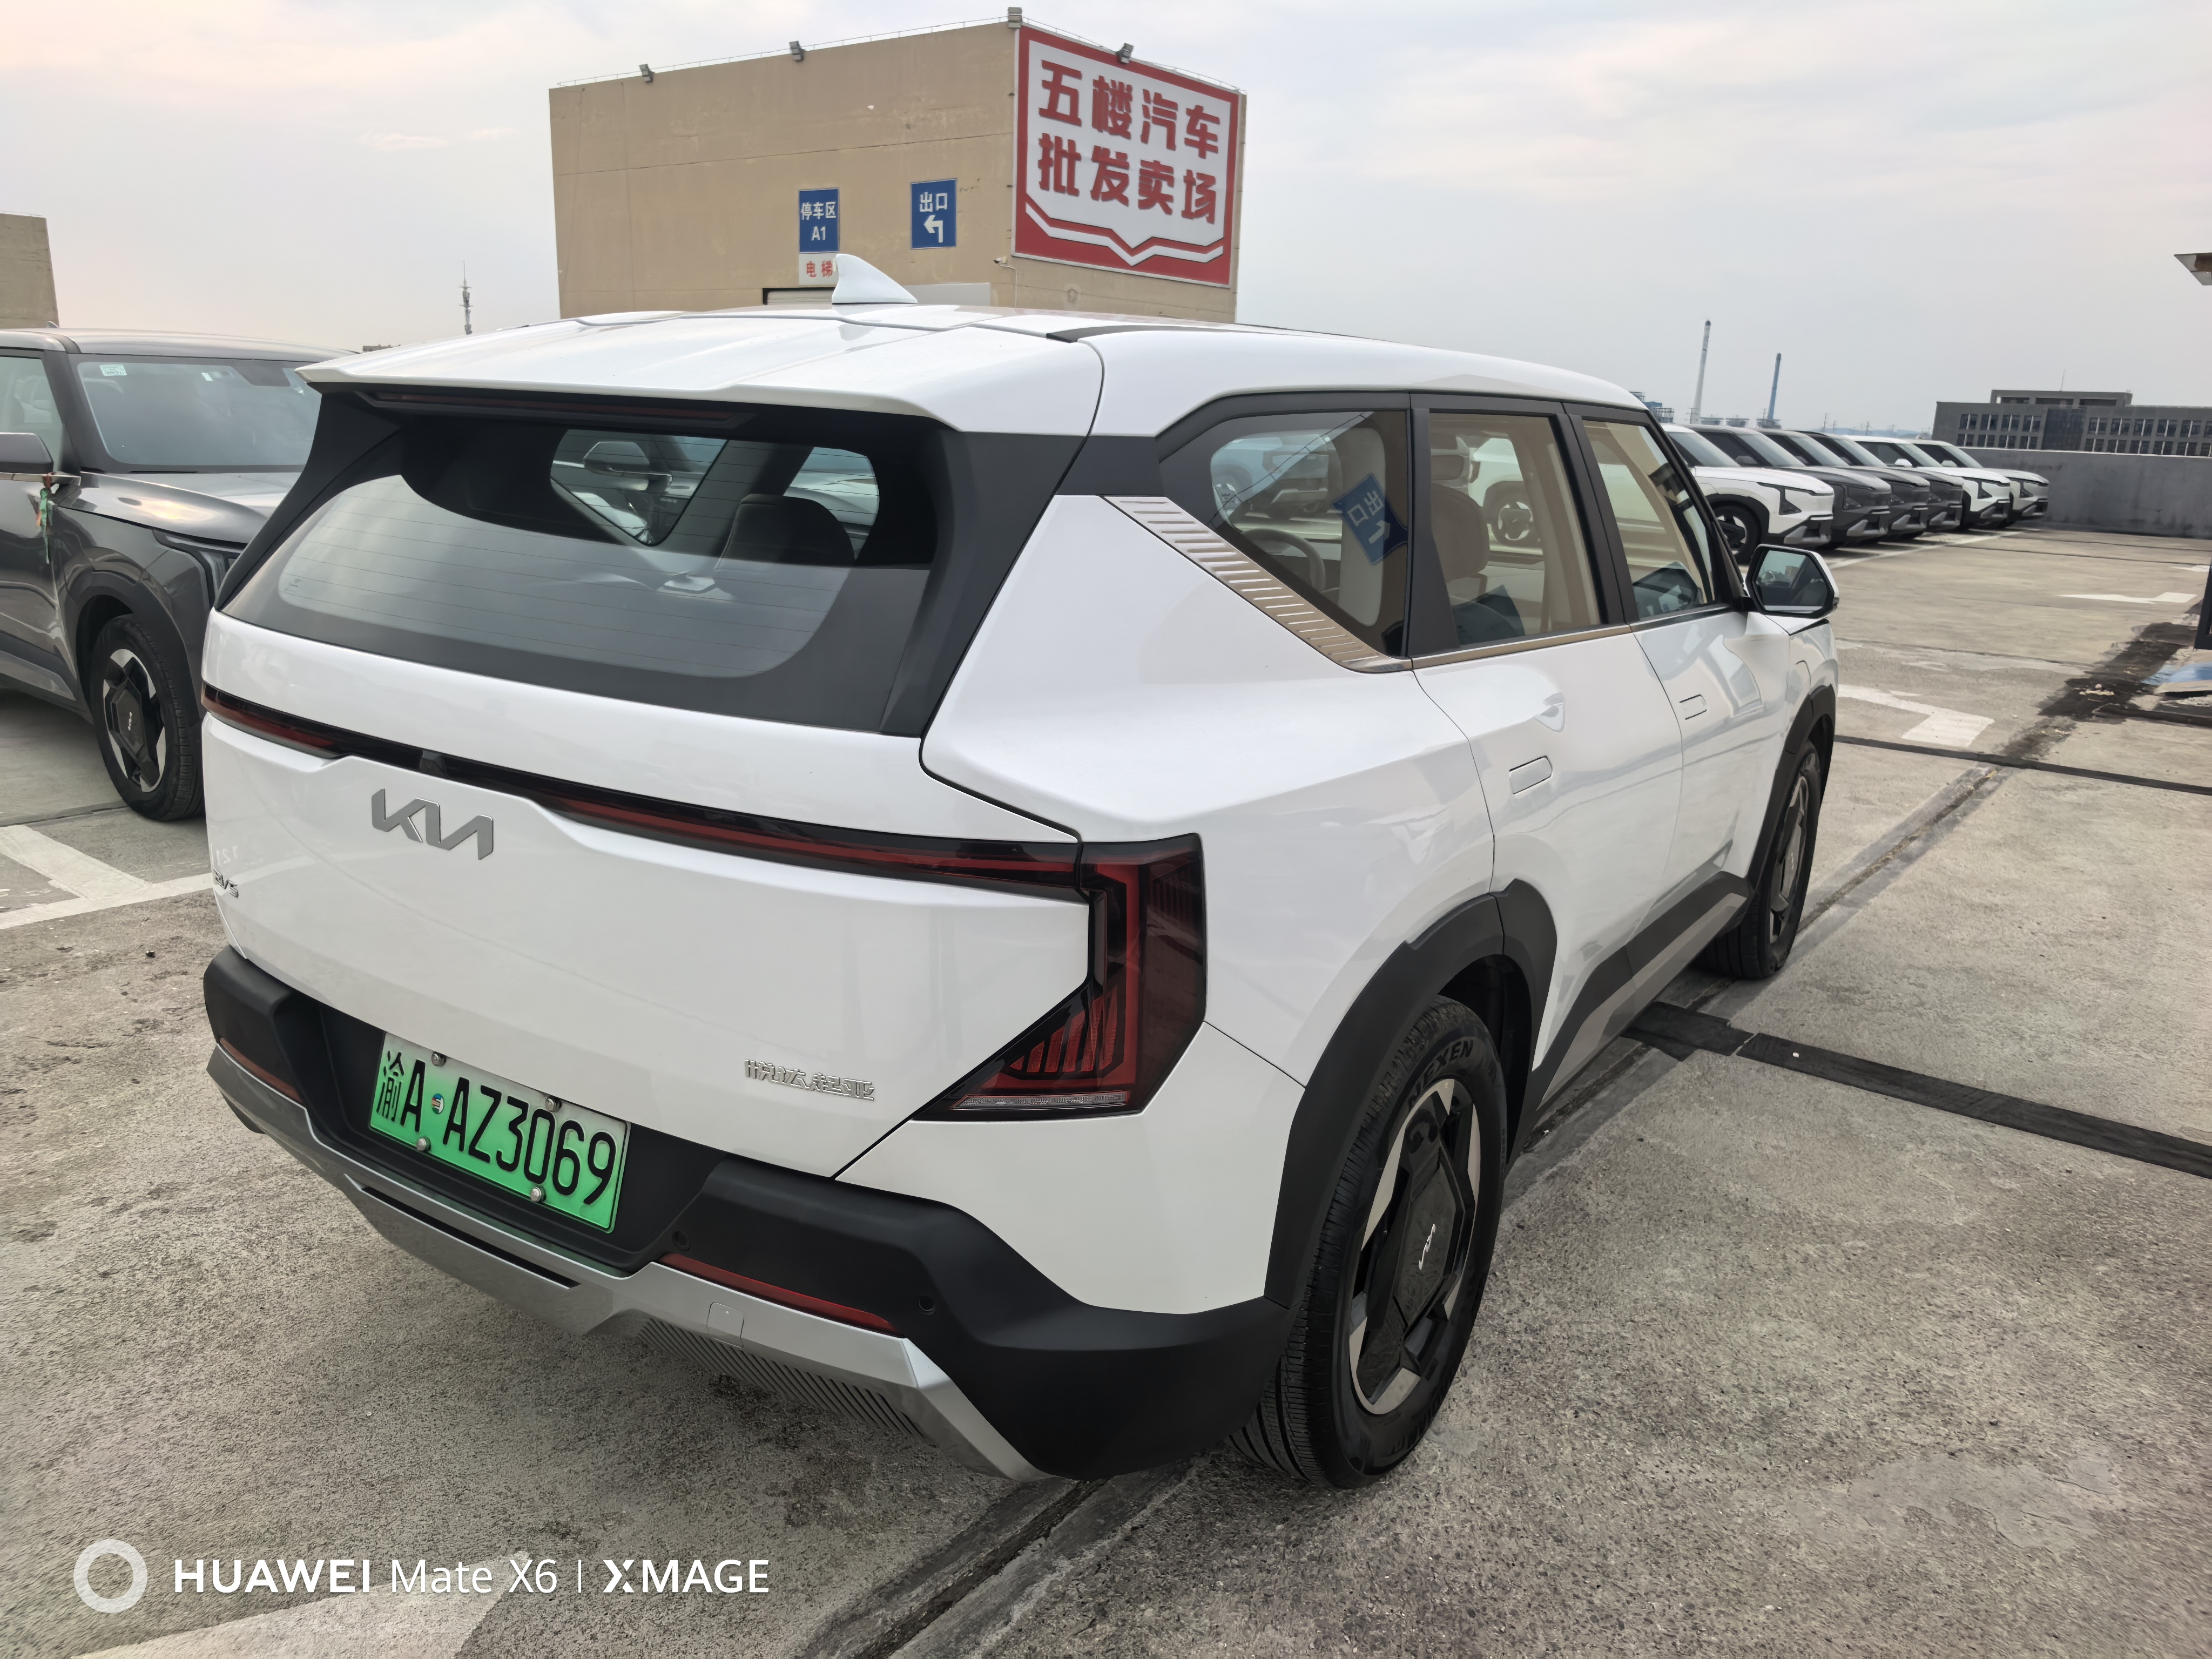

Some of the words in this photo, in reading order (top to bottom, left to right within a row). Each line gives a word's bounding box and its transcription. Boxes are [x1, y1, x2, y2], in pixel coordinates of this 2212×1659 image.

[1038, 59, 1220, 159] 五楼汽车
[1037, 132, 1216, 224] 批发卖场
[801, 201, 837, 220] 停车区
[920, 192, 948, 212] 出口
[812, 226, 826, 241] A1
[806, 260, 833, 278] 电梯
[372, 788, 494, 860] KIA
[442, 1077, 616, 1205] AZ3069
